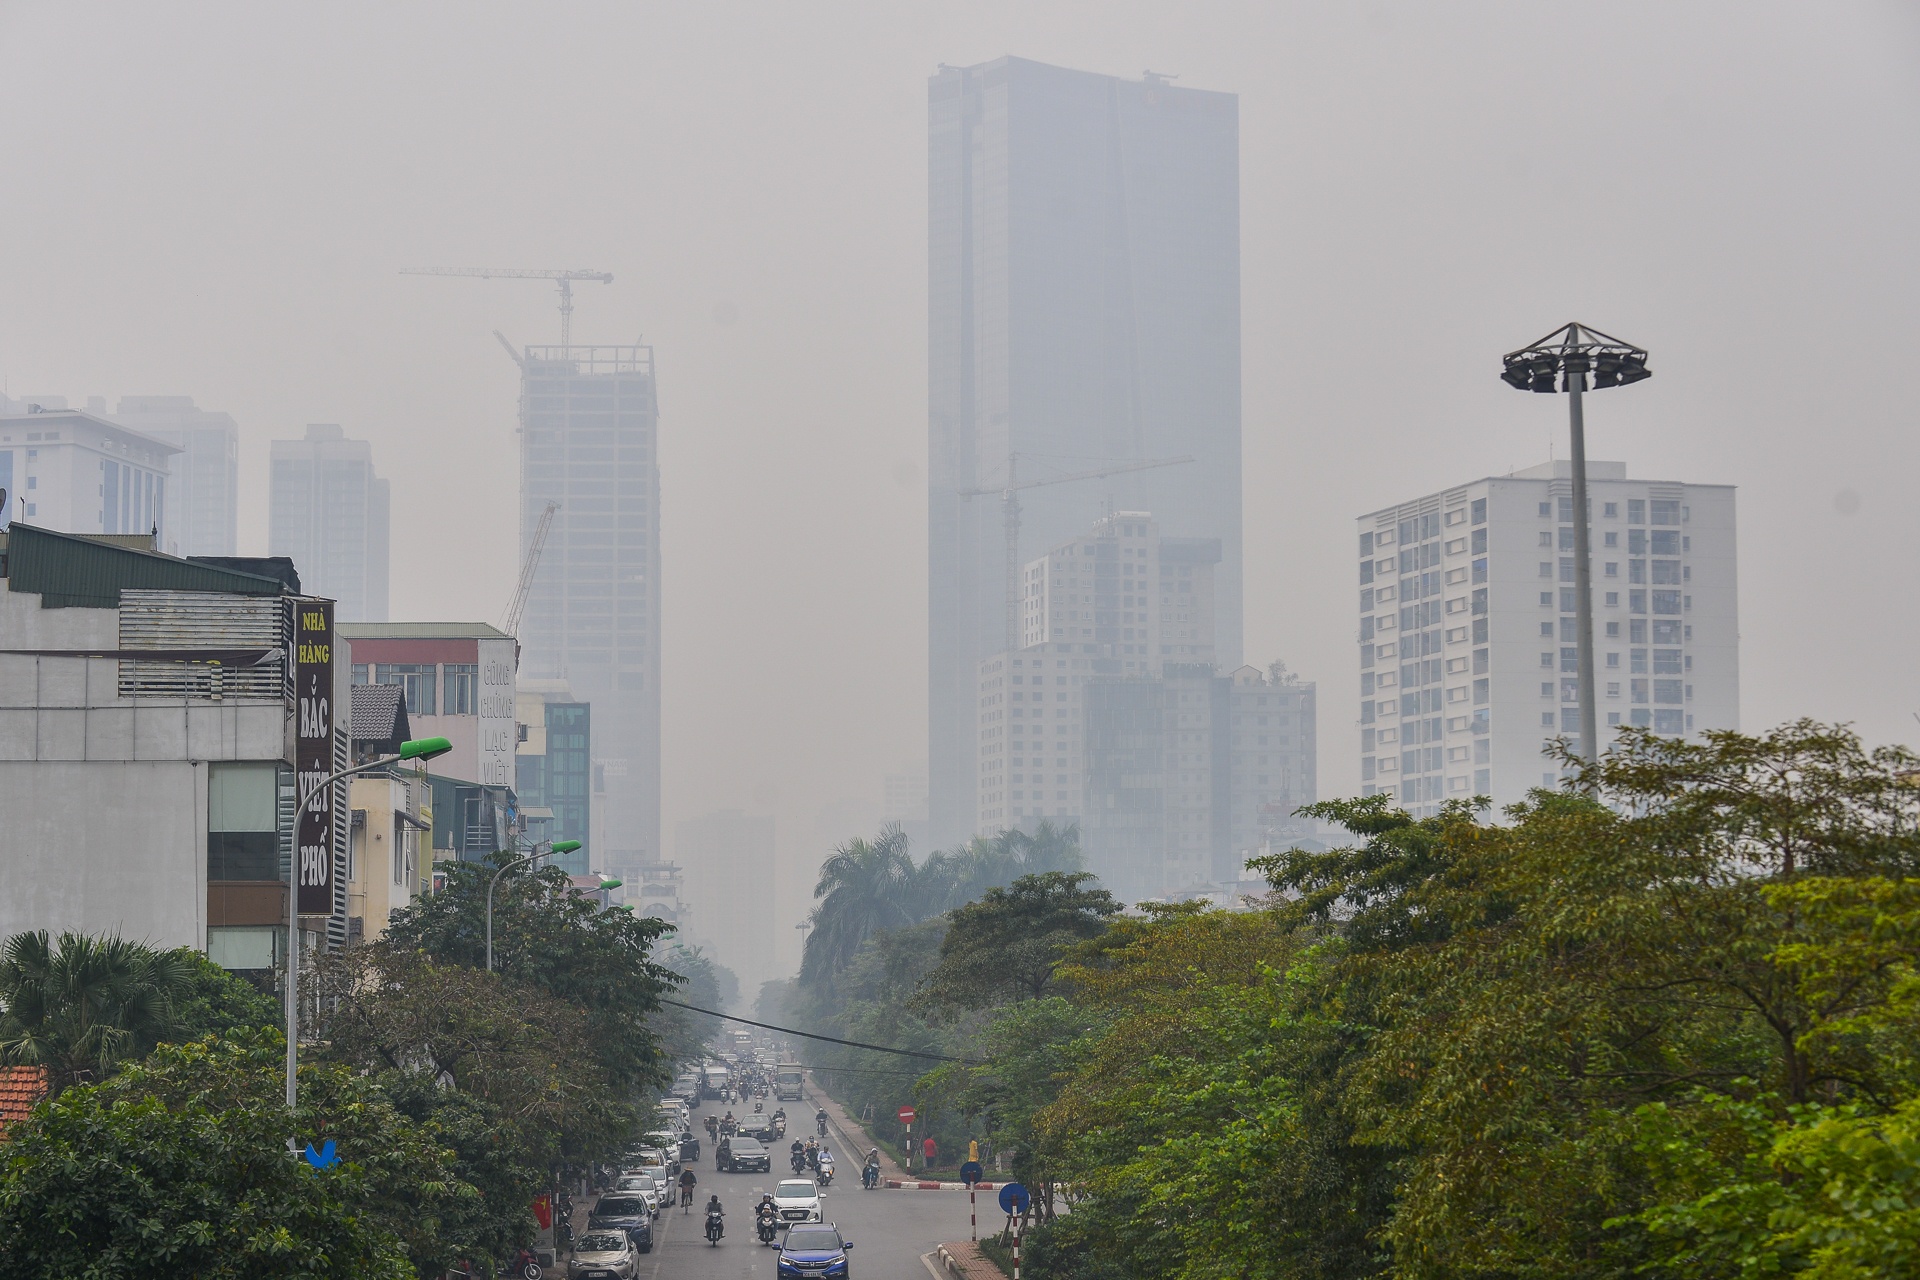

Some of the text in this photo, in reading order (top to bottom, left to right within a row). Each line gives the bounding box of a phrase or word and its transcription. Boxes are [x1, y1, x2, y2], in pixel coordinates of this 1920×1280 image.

[303, 607, 326, 631] NHÀ
[299, 640, 329, 664] HÀNG
[484, 659, 510, 686] CÔNG
[300, 674, 328, 738] BẮC
[484, 729, 508, 757] LẠC
[607, 760, 627, 768] NAM
[298, 758, 330, 823] VIỆT
[300, 825, 328, 887] PHỐ
